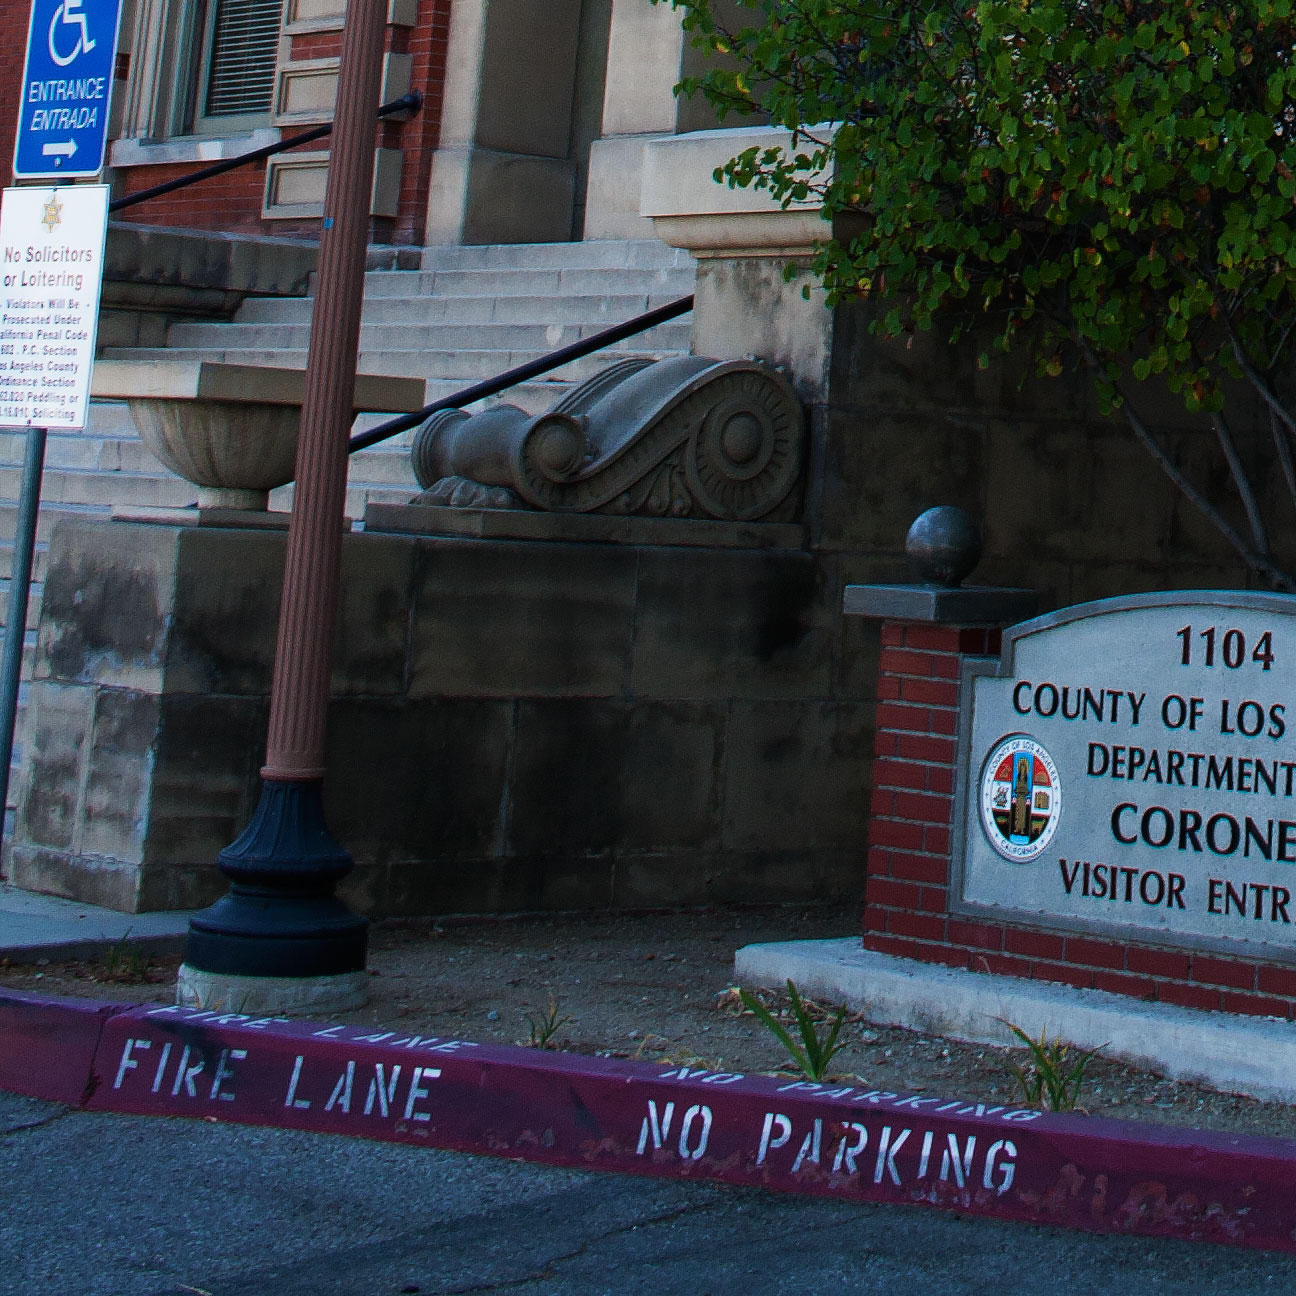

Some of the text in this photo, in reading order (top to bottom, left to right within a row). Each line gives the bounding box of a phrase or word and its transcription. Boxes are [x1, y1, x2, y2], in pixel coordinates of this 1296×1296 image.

[28, 77, 105, 102] ENTRANCE
[30, 107, 98, 131] ENTRADA
[4, 245, 93, 263] No Solicitors
[3, 270, 83, 291] or Loitering
[7, 298, 44, 309] Violators
[48, 298, 66, 309] Will
[3, 313, 81, 324] Prosecuted Under
[0, 329, 88, 340] alifornia Penal Code
[43, 344, 78, 356] Section
[10, 360, 43, 374] Angeles
[48, 360, 79, 375] County
[41, 375, 76, 387] Section
[27, 391, 66, 406] Peddling
[69, 395, 79, 404] or
[1176, 625, 1275, 671] 1104
[1012, 680, 1145, 726] COUNTY
[1161, 693, 1204, 732] OF
[1220, 699, 1286, 741] LOS
[1058, 859, 1186, 909] VISITOR
[147, 1005, 479, 1054] FIRE LANE
[114, 1038, 442, 1122] FIRE LANE
[658, 1068, 1044, 1122] NO PARKING
[636, 1099, 1018, 1197] NO PARKING
